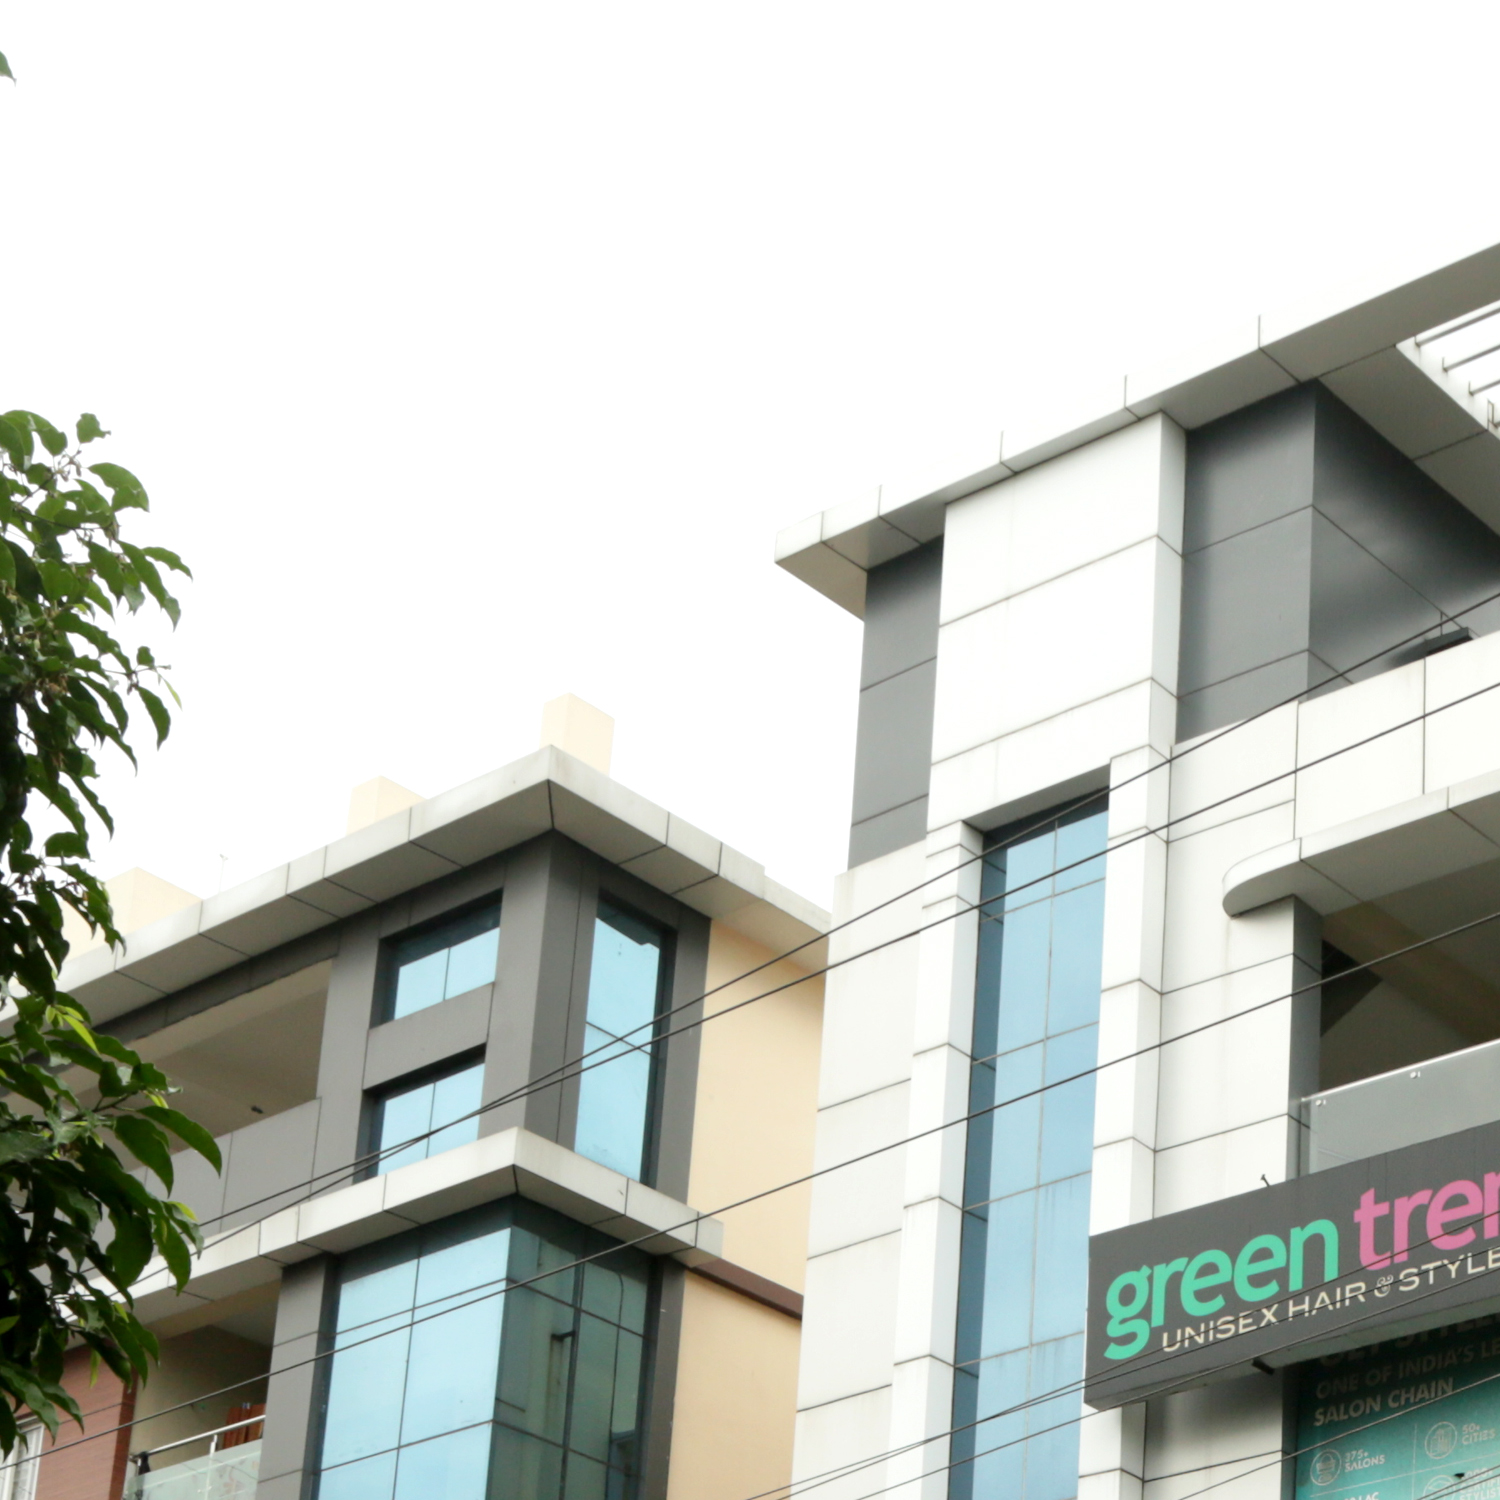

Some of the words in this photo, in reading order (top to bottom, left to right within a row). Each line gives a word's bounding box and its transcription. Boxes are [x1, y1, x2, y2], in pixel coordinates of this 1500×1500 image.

[1103, 1217, 1339, 1360] green
[1162, 1305, 1279, 1353] UNISEX
[1287, 1280, 1366, 1322] HAIR
[1374, 1274, 1394, 1297] &
[1313, 1393, 1382, 1427] SALON
[1387, 1376, 1455, 1408] CHAIN
[1315, 1376, 1359, 1399] ONE
[1364, 1366, 1392, 1387] OF
[1461, 1427, 1496, 1445] CITIES
[1344, 1455, 1386, 1473] SALONS
